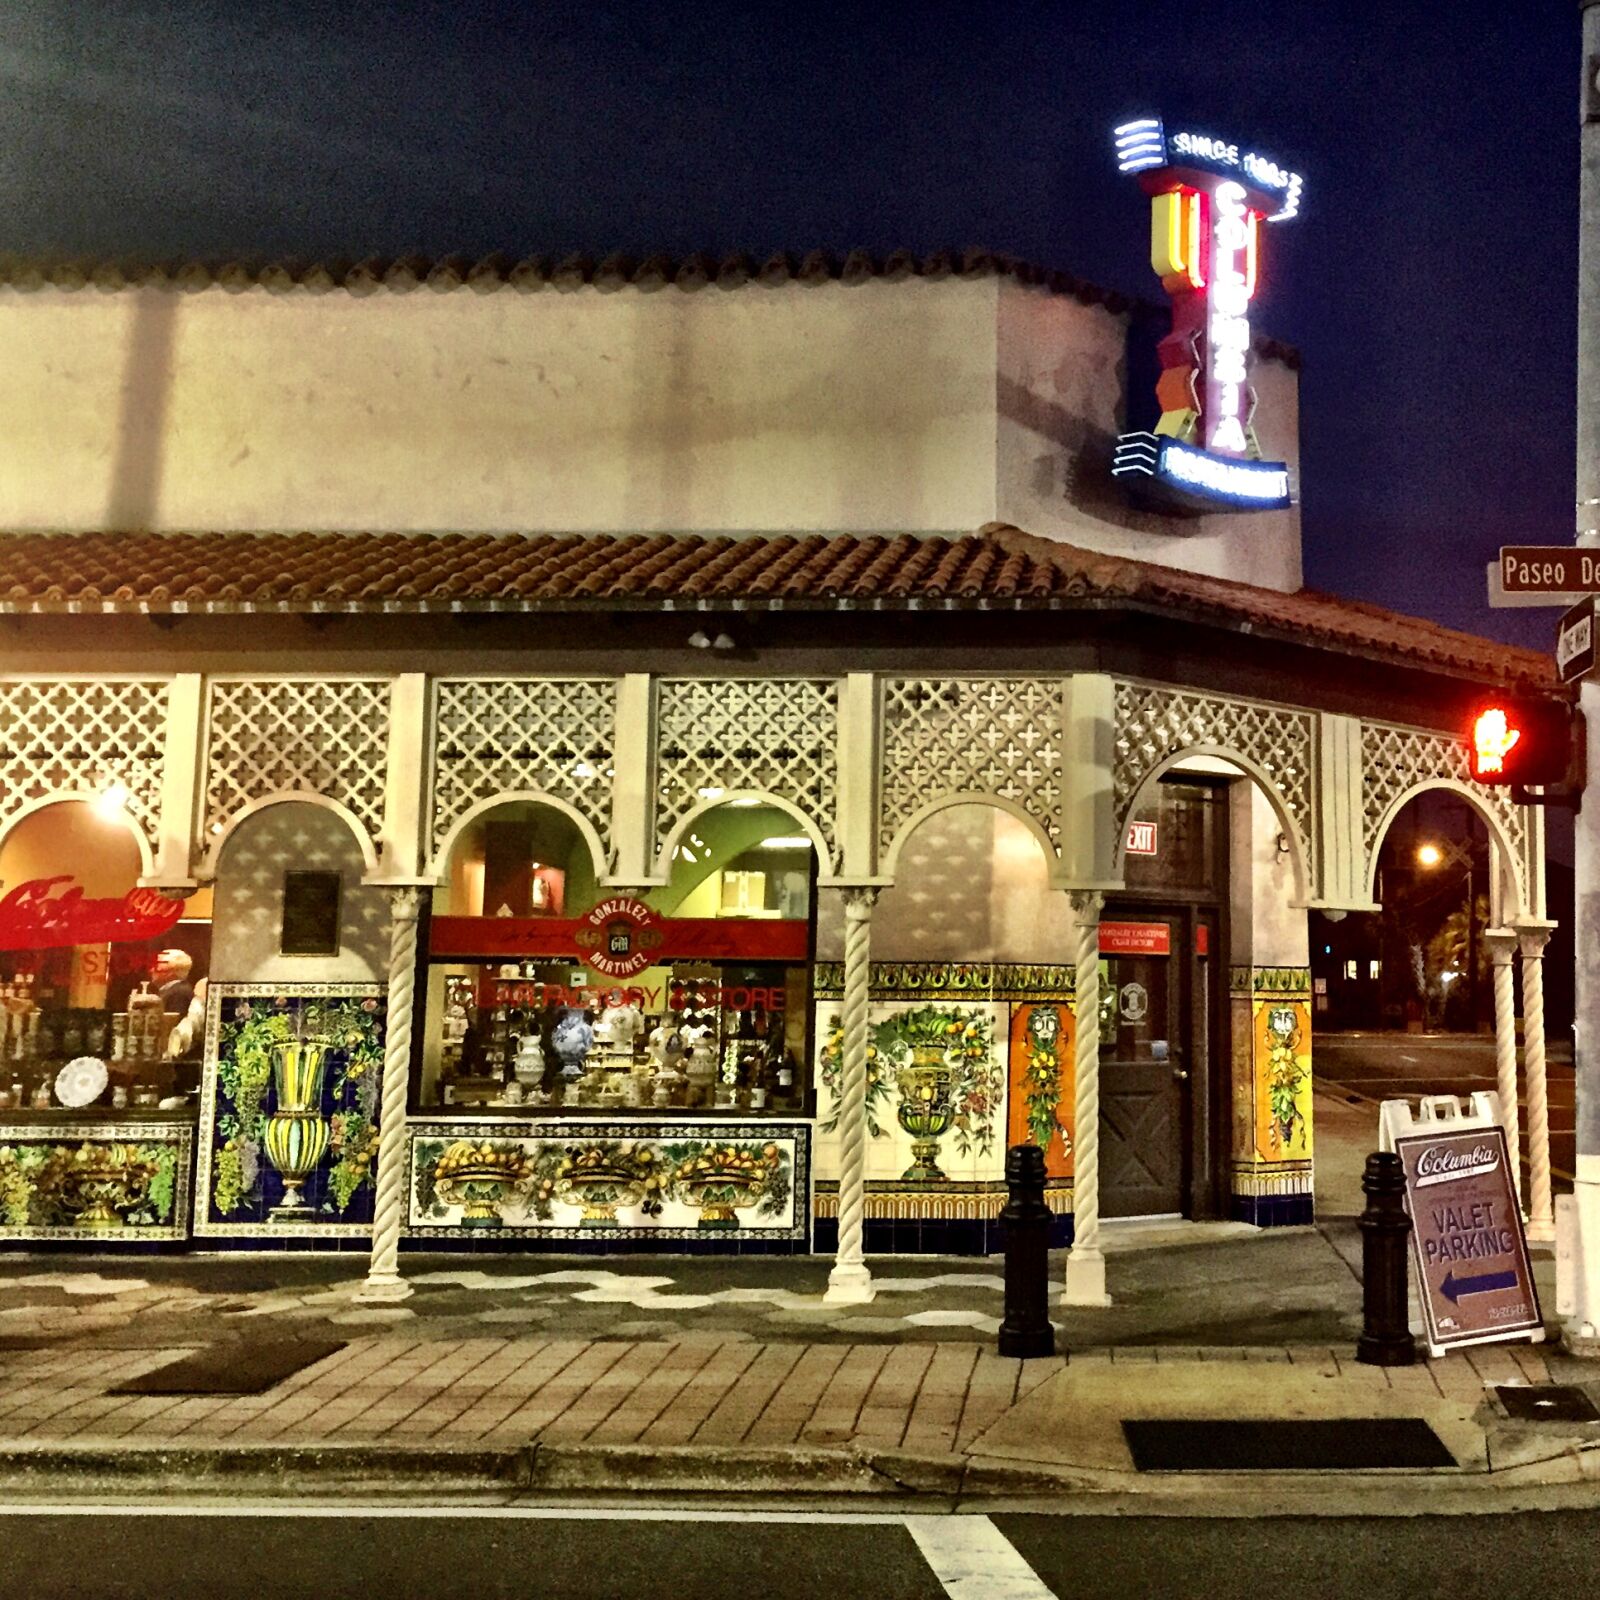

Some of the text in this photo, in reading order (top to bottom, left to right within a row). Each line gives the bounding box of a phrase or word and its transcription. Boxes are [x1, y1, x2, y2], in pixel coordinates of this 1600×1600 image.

[1506, 556, 1565, 584] Paseo
[1127, 825, 1153, 850] EXIT
[589, 899, 648, 926] GONZALEZ
[589, 951, 648, 974] MARTINEZ
[542, 985, 661, 1010] FACTORY
[1417, 1144, 1496, 1176] Columbia
[1432, 1202, 1494, 1234] VALET
[1425, 1229, 1515, 1265] PARKING
